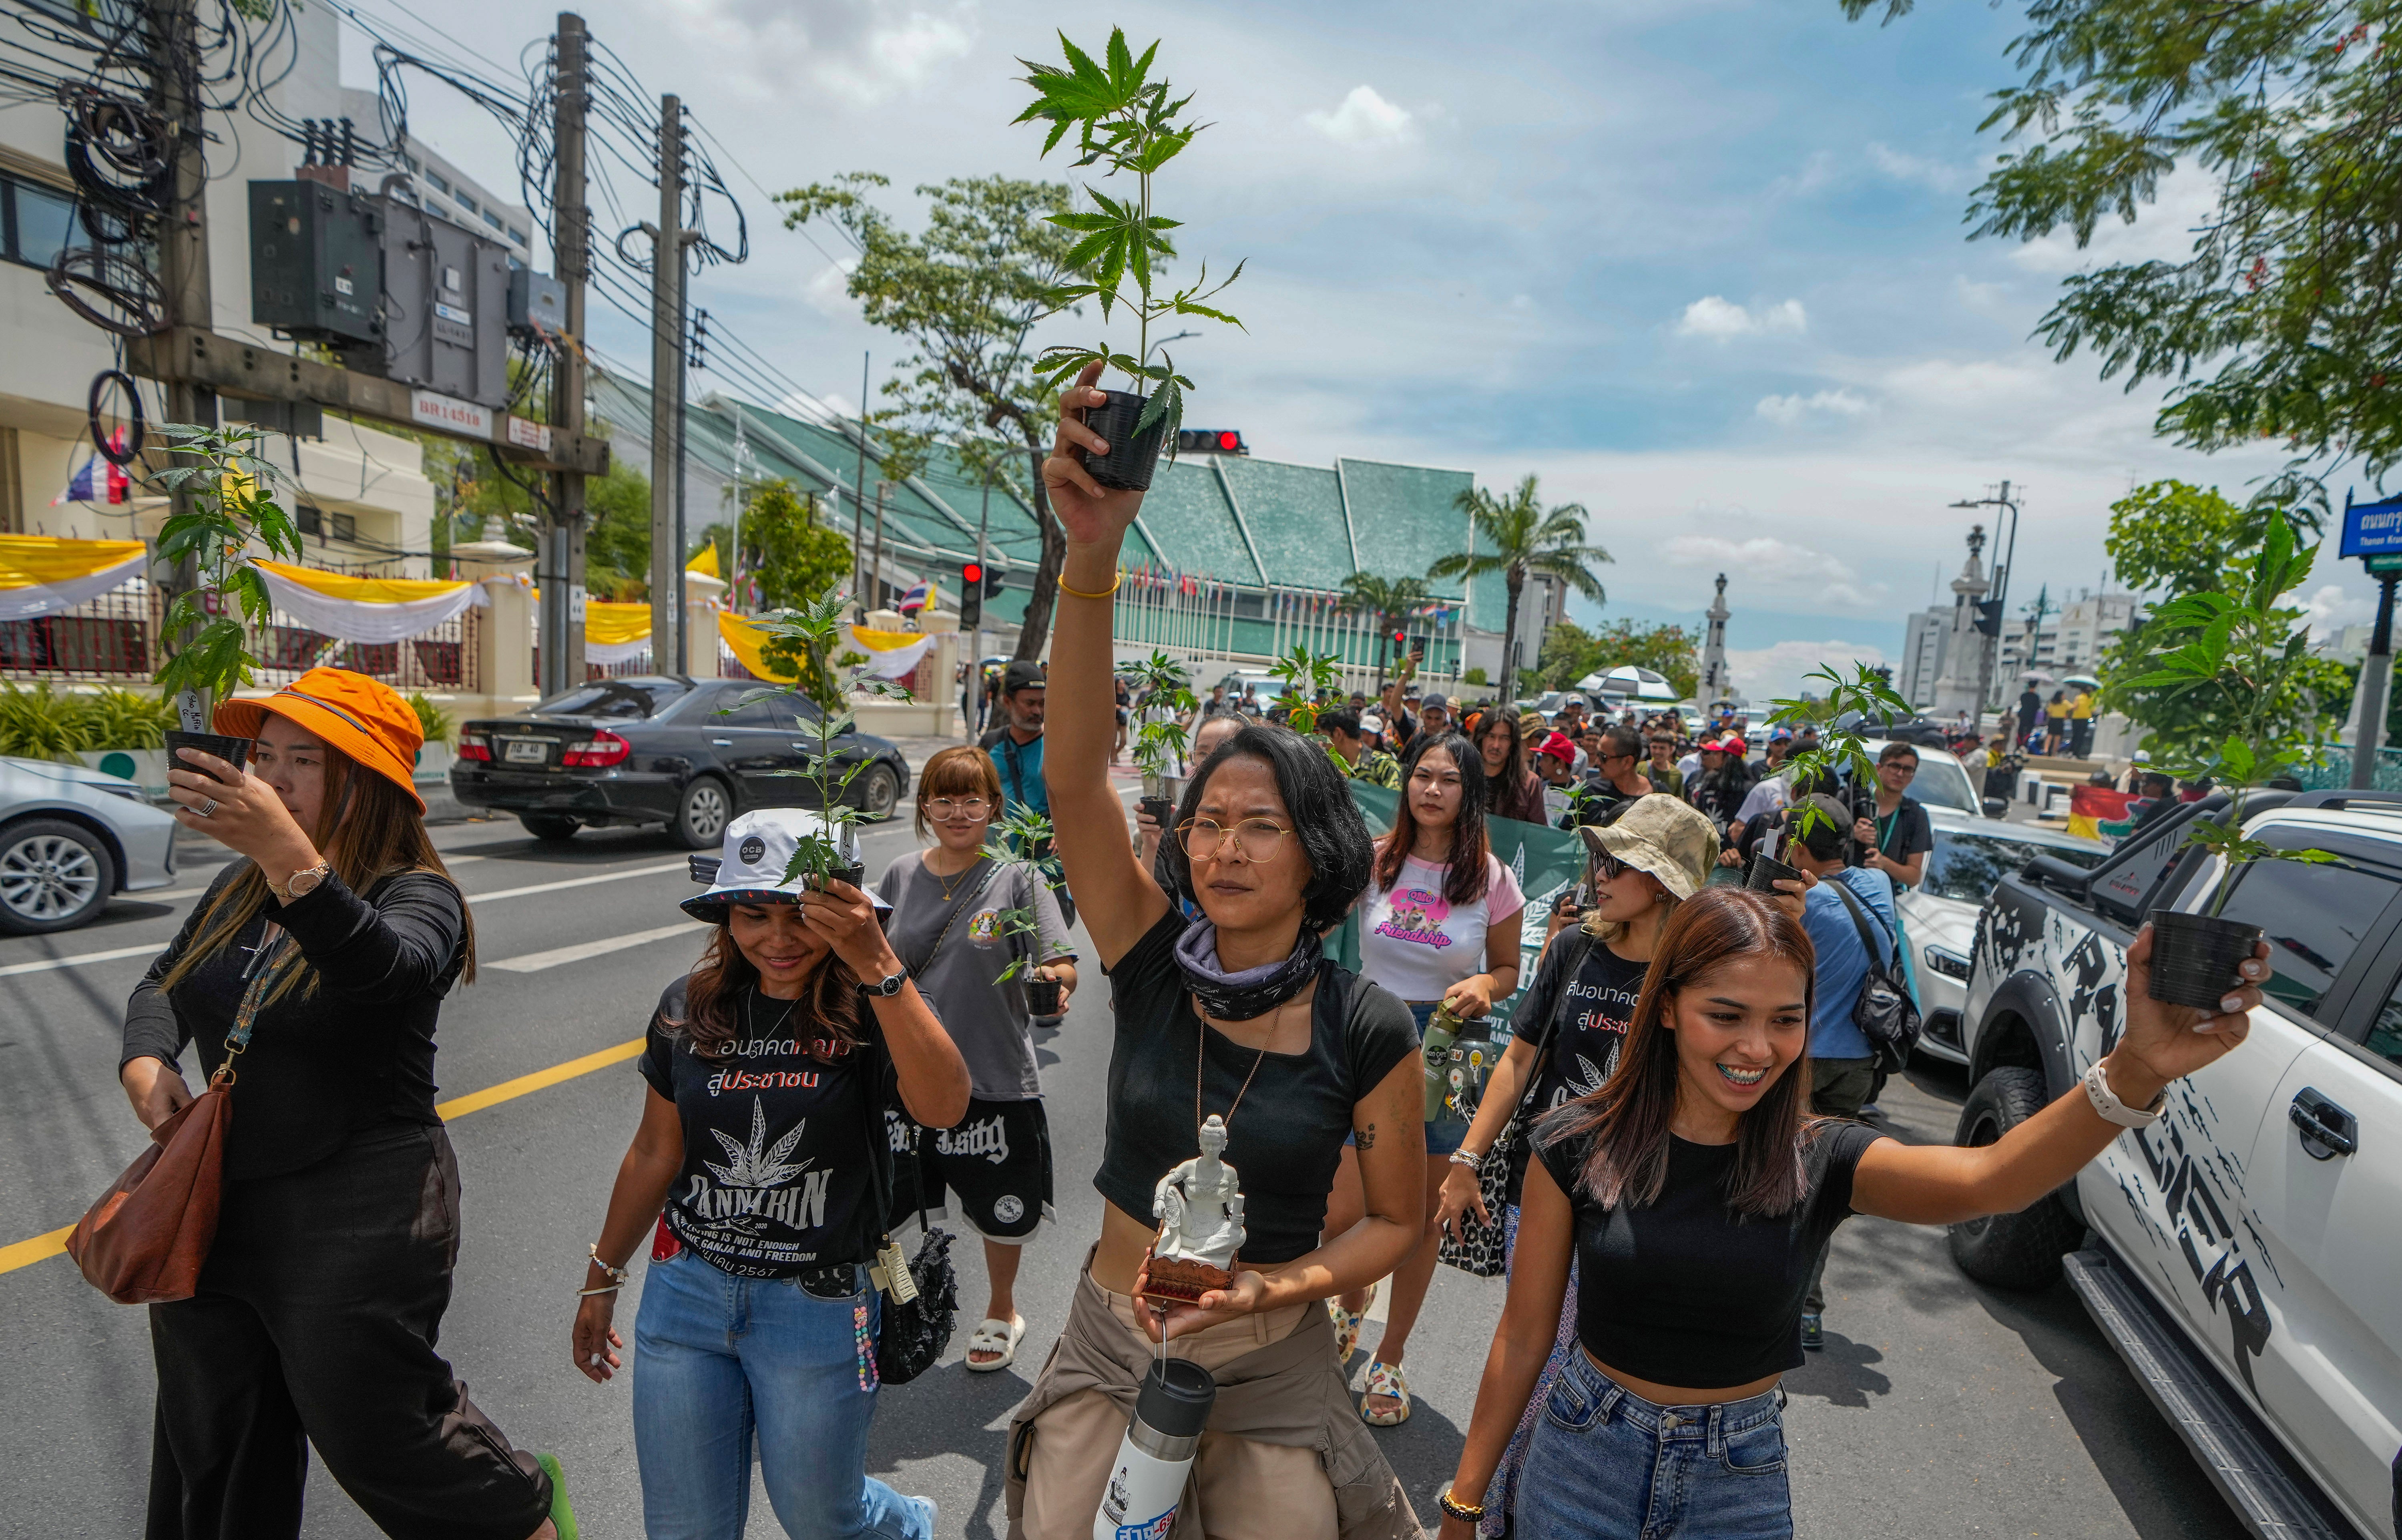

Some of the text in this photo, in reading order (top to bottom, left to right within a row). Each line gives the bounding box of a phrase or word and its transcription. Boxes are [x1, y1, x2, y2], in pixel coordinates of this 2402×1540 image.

[2360, 536, 2385, 546] Thanon
[742, 846, 762, 854] OCB
[1410, 891, 1433, 903] OMG
[1374, 921, 1452, 949] Friendship
[1577, 1009, 1632, 1031] สู่ประช
[1489, 1030, 1513, 1046] AND
[707, 1068, 819, 1097] สู่ประชาชน
[721, 1232, 731, 1242] IS
[734, 1235, 756, 1248] NOT
[757, 1240, 800, 1251] ENOUGH
[701, 1239, 735, 1254] GANJA
[737, 1247, 763, 1259] AND
[764, 1250, 817, 1262] FREEDOM
[736, 1265, 777, 1277] 2567
